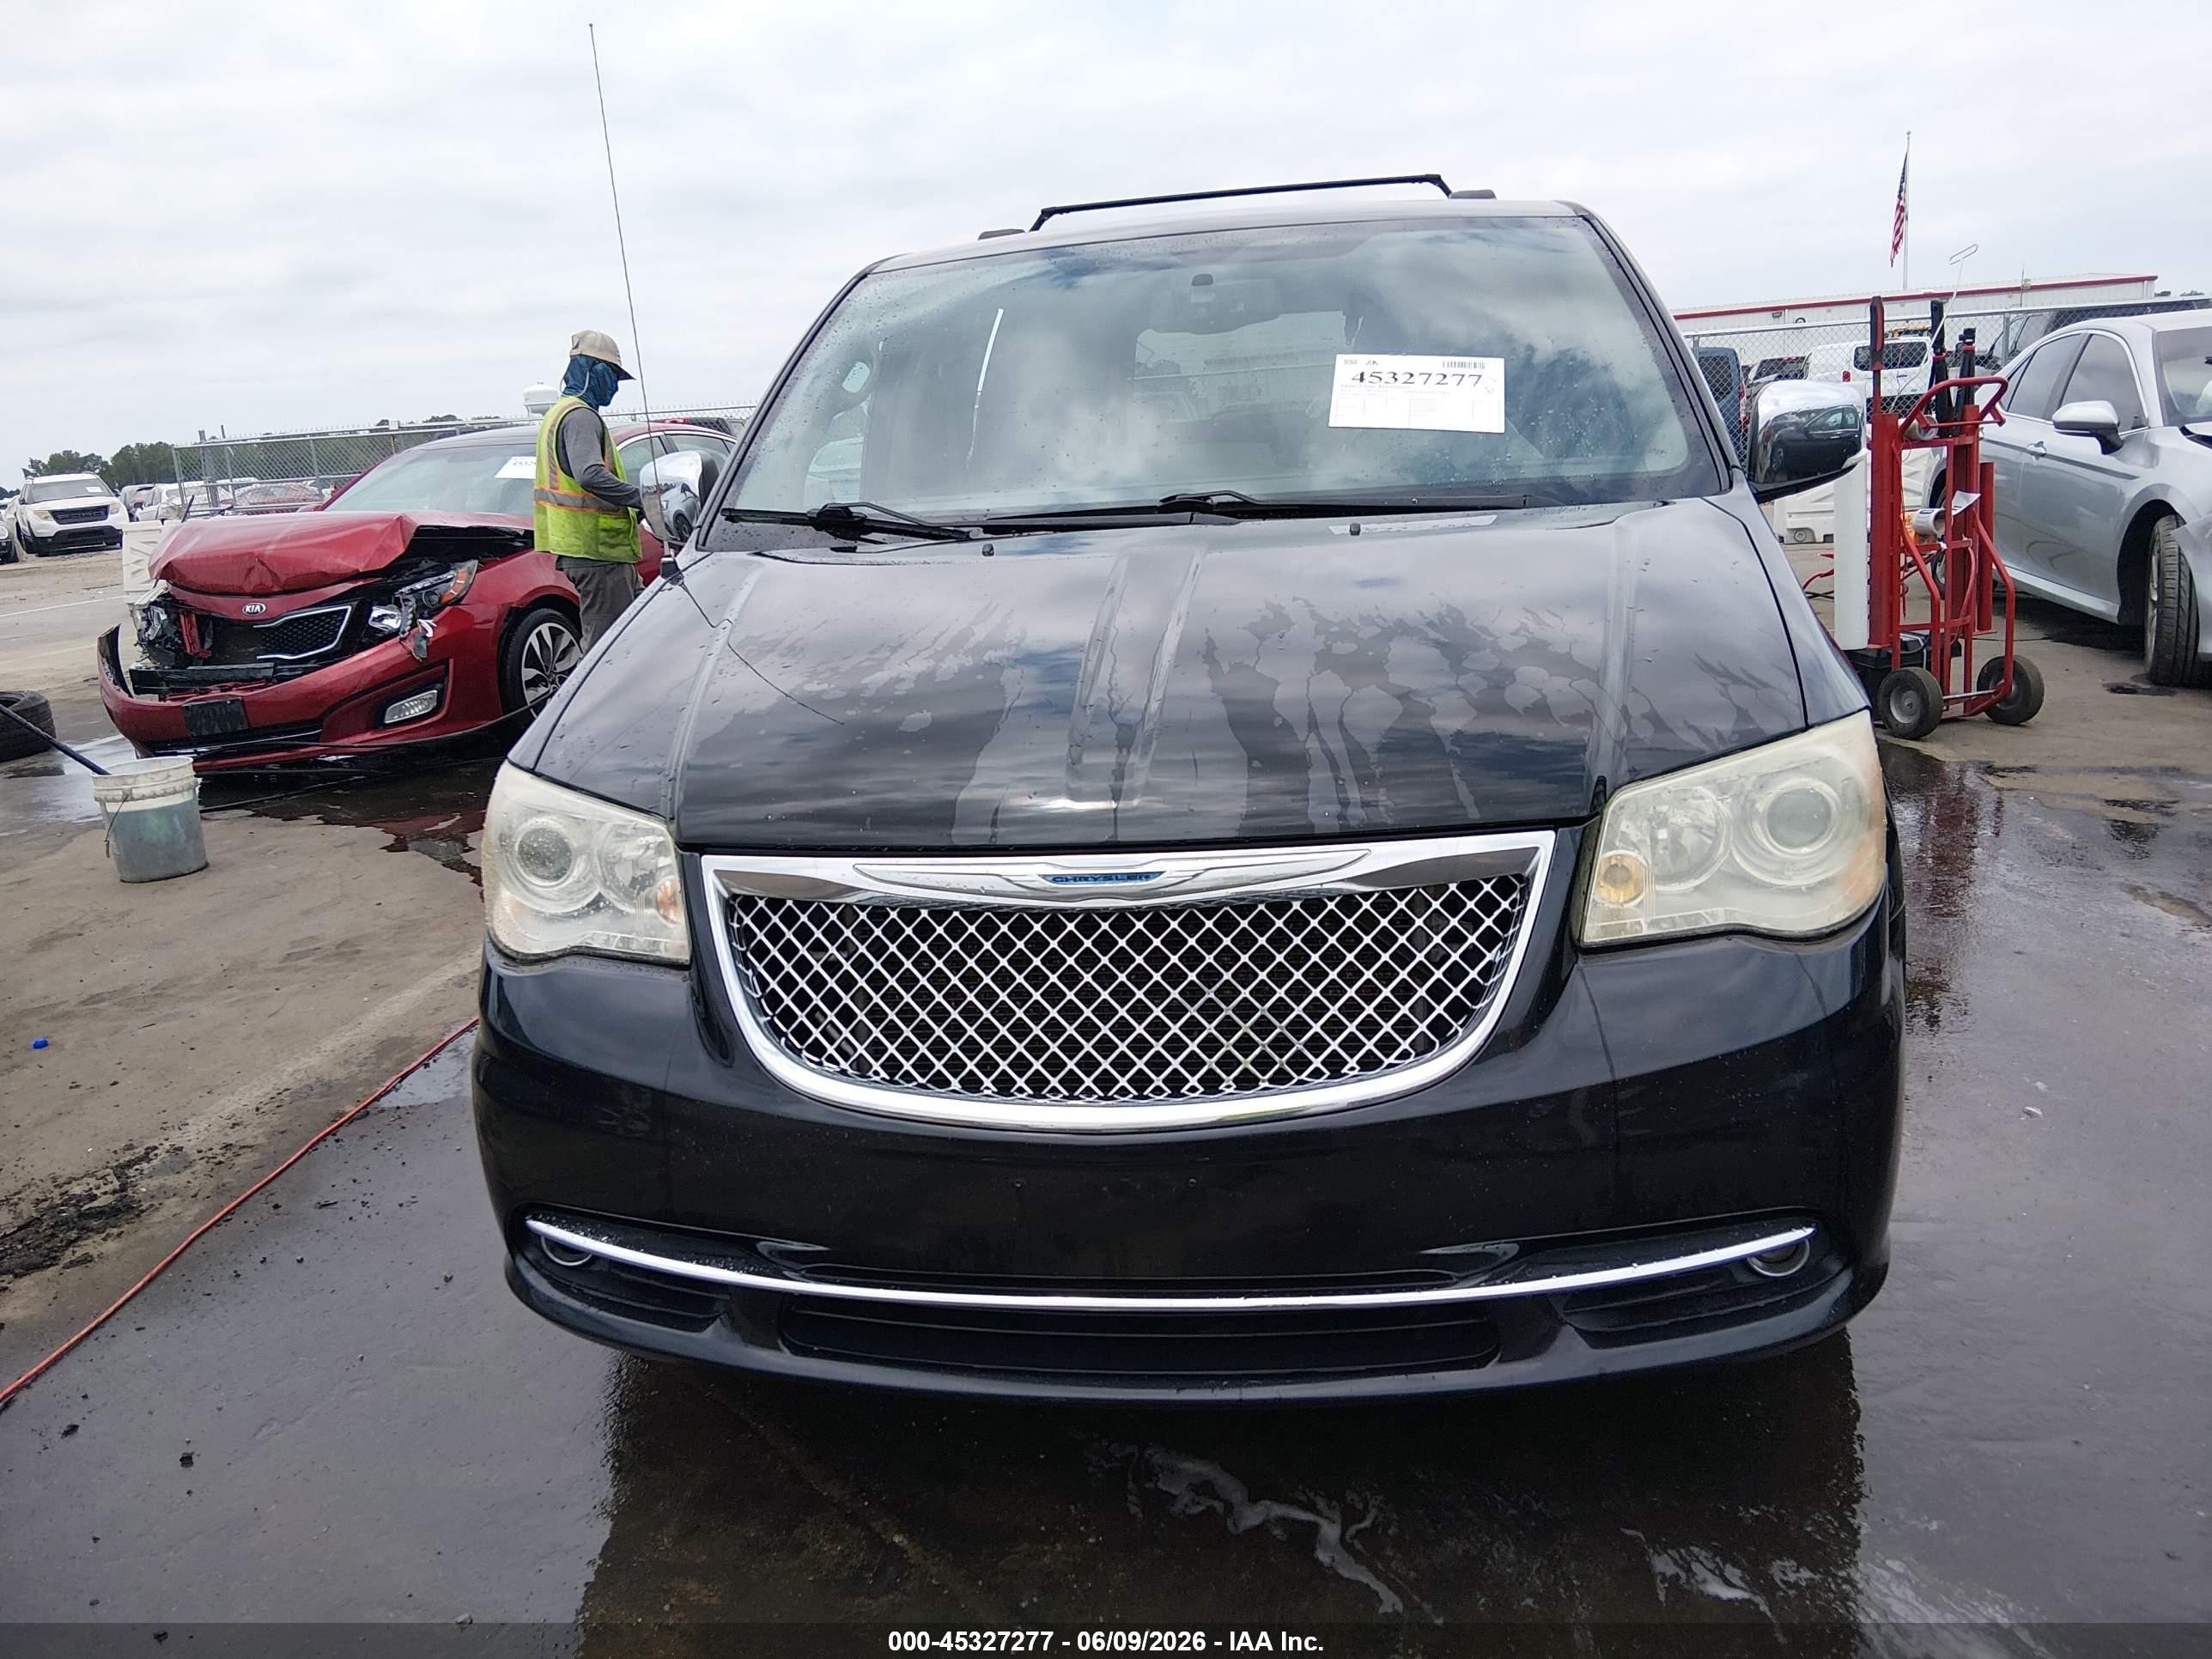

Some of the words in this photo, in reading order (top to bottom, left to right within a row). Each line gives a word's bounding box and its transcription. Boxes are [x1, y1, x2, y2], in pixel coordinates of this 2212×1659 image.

[1352, 371, 1483, 386] 45327277
[246, 605, 261, 613] KIA
[1051, 874, 1152, 883] CHRYSLER
